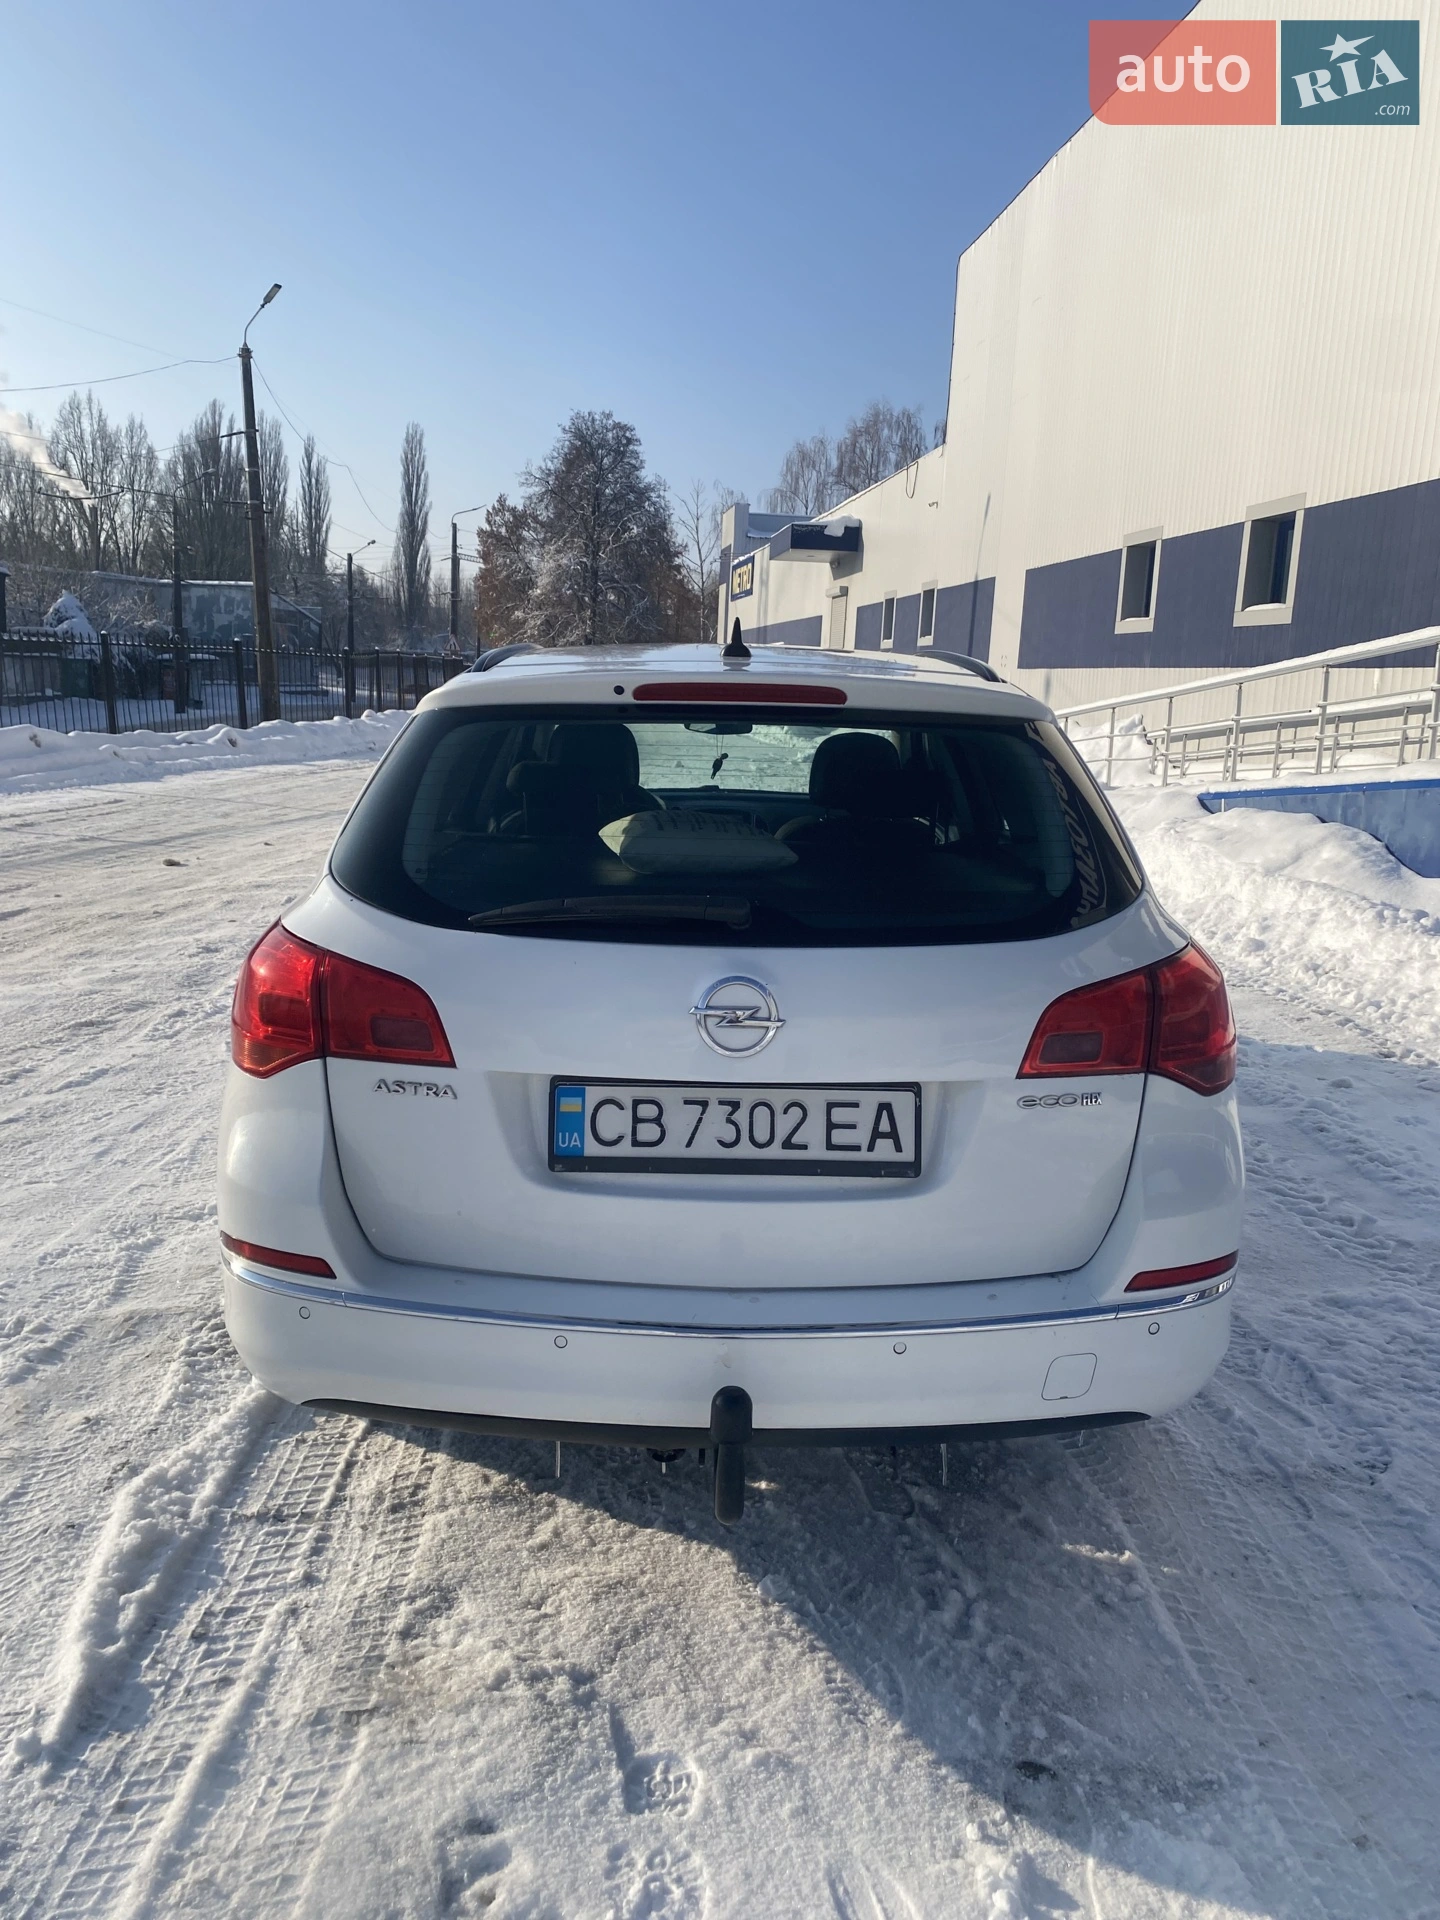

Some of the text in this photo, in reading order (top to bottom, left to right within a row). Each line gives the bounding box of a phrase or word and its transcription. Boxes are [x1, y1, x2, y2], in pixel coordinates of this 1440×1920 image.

[732, 562, 752, 595] METRO
[373, 1078, 458, 1100] ASTRA
[589, 1097, 903, 1153] CB 7302 EA
[558, 1131, 582, 1149] UA
